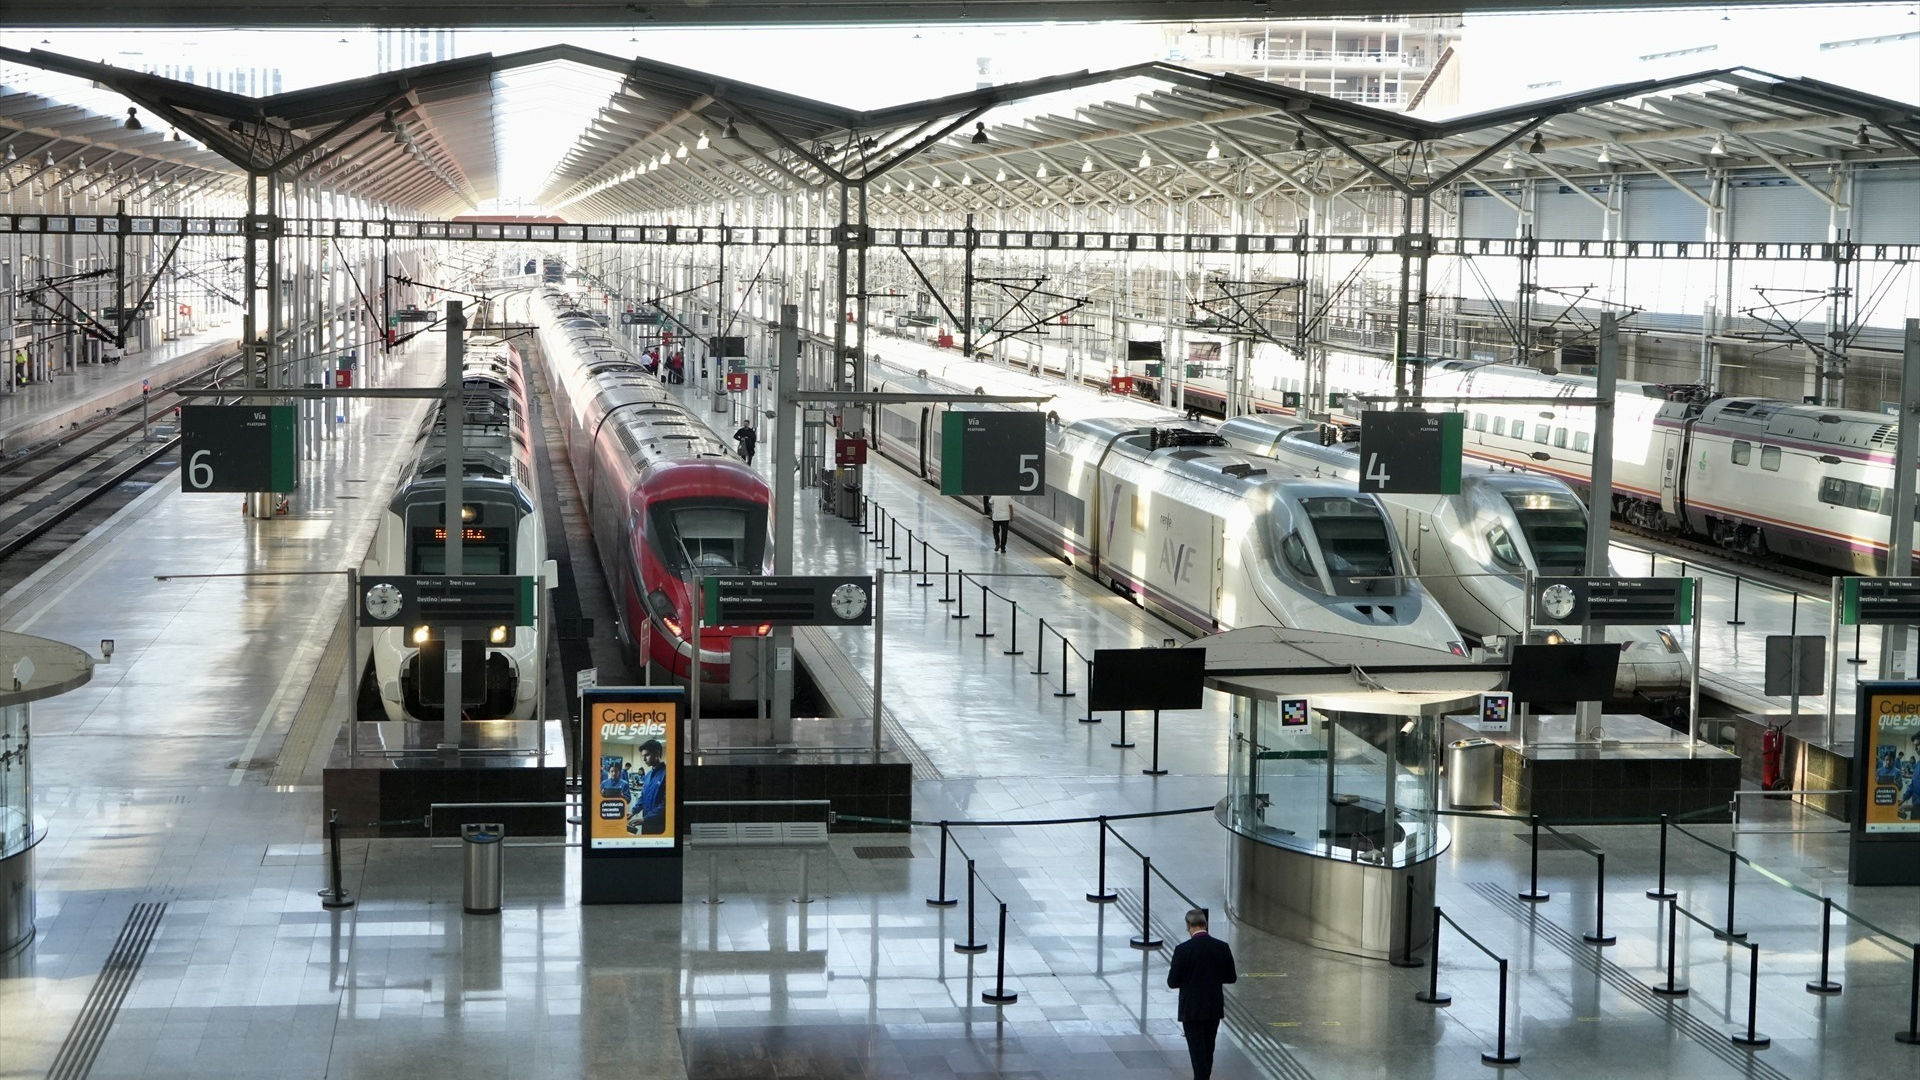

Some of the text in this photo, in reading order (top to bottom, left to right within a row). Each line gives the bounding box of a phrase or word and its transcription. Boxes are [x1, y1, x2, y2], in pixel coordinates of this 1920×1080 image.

[254, 412, 266, 420] Vía
[189, 450, 214, 489] 6
[1019, 454, 1039, 491] 5
[1366, 453, 1390, 488] 4
[1160, 537, 1197, 587] AVE
[601, 718, 666, 740] que sales
[602, 708, 666, 723] Calienta
[1878, 714, 1920, 730] que sa
